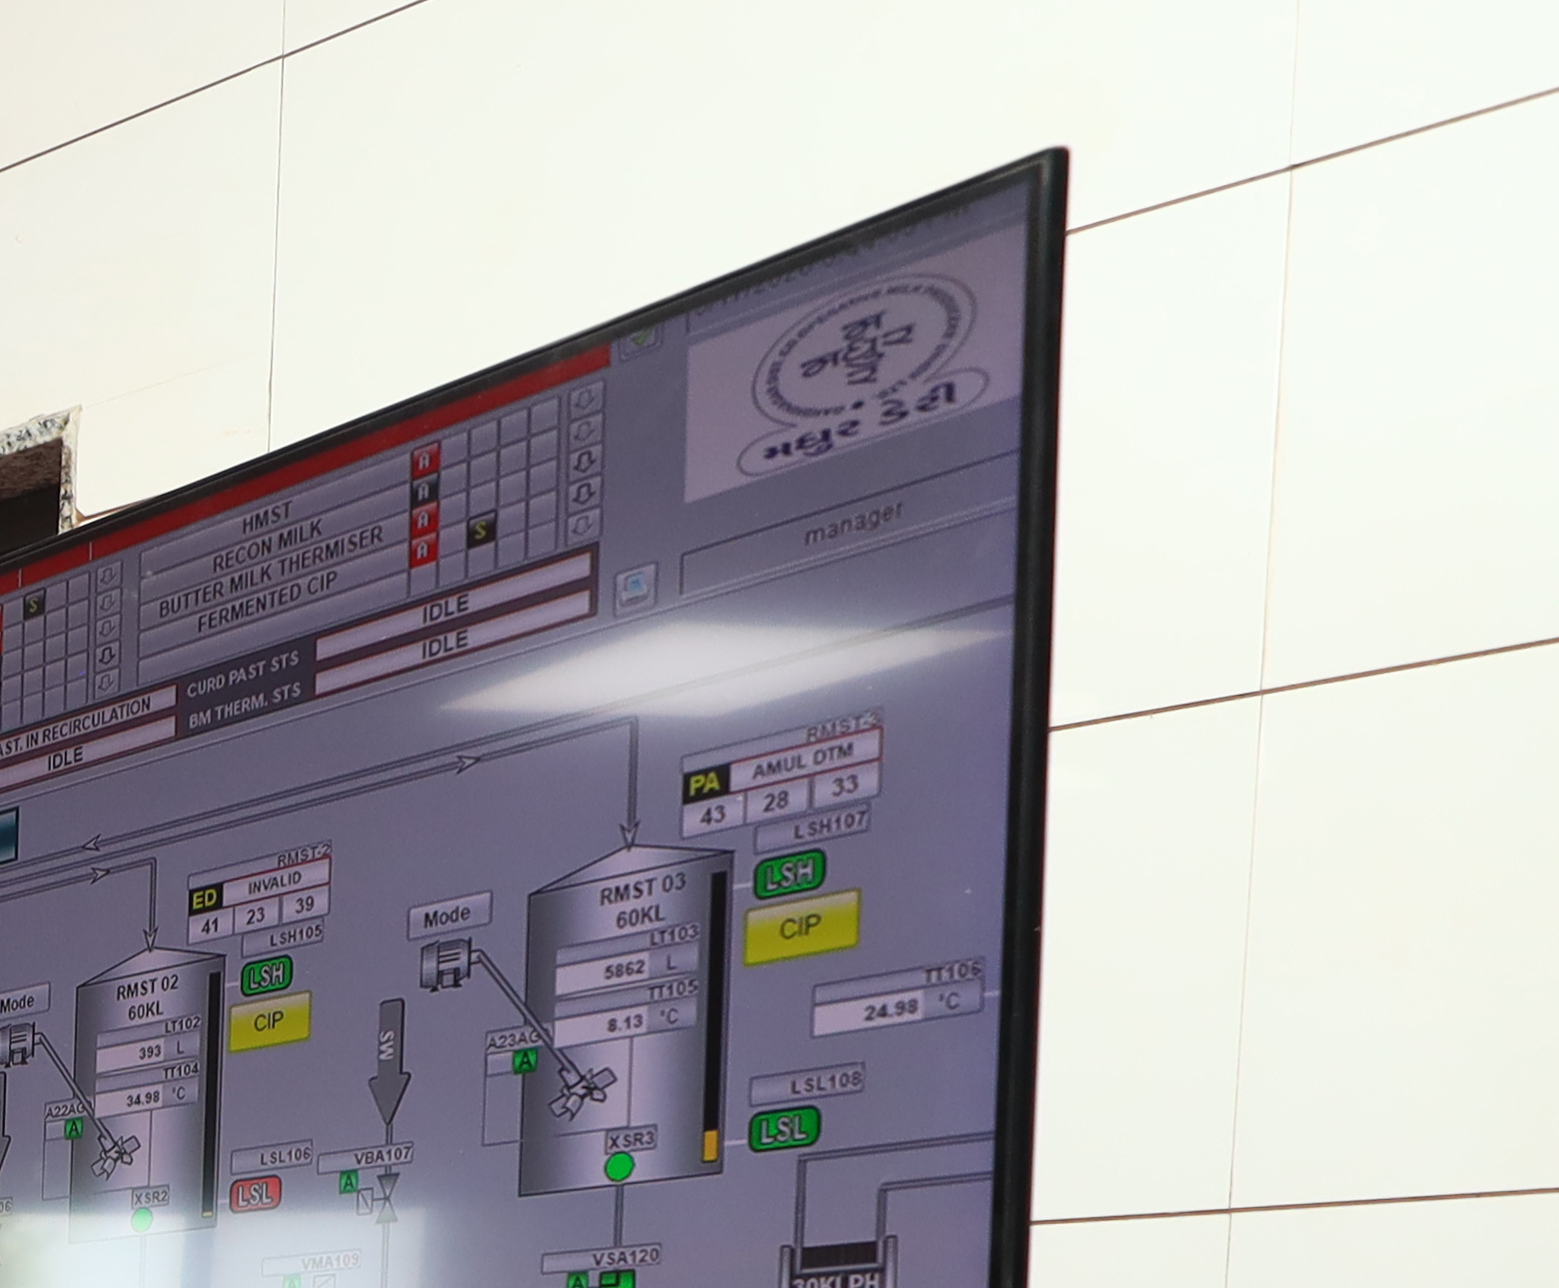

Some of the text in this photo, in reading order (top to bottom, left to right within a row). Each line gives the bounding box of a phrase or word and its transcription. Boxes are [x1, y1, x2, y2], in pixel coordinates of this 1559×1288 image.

[242, 502, 292, 534] HMST
[804, 502, 904, 546] manager
[212, 519, 322, 573] RECON MILK
[159, 526, 383, 619] BUTTER MILK THERMISER
[197, 571, 338, 633] FERMENTED CIP
[423, 595, 469, 624] IDLE
[423, 630, 469, 660] IDLE
[187, 650, 299, 699] CURD PAST STS
[189, 682, 302, 730] BM THERM. STS
[26, 732, 39, 748] IN
[41, 697, 151, 744] RECIRCULATION
[48, 748, 84, 772] IDLE
[752, 742, 854, 780] AMUL DTM
[689, 772, 721, 798] PA
[831, 775, 859, 796] 33
[700, 803, 727, 825] 43
[763, 792, 790, 812] 28
[794, 810, 867, 840] LSH107
[247, 871, 302, 894] INVALID
[765, 860, 815, 891] LSH
[192, 889, 217, 910] ED
[599, 873, 686, 907] RMST 03
[246, 907, 265, 925] 23
[295, 896, 315, 914] 39
[201, 918, 219, 935] 41
[423, 906, 472, 929] Mode
[616, 909, 666, 931] 60KL
[779, 913, 823, 940] CIP
[270, 924, 322, 948] LSH105
[648, 925, 700, 947] LT103
[249, 962, 284, 990] LSH
[925, 961, 982, 983] TT106
[116, 974, 179, 1002] RMST 02
[648, 979, 699, 1000] TT105
[0, 993, 35, 1014] Mode
[127, 1001, 164, 1021] 60KL
[164, 1015, 201, 1036] LT102
[254, 1010, 285, 1032] CIP
[163, 1062, 200, 1079] TT104
[790, 1070, 863, 1095] LSL108
[760, 1115, 809, 1144] LSL
[260, 1146, 311, 1166] LSL106
[354, 1146, 412, 1166] VBA107
[237, 1182, 272, 1207] LSL
